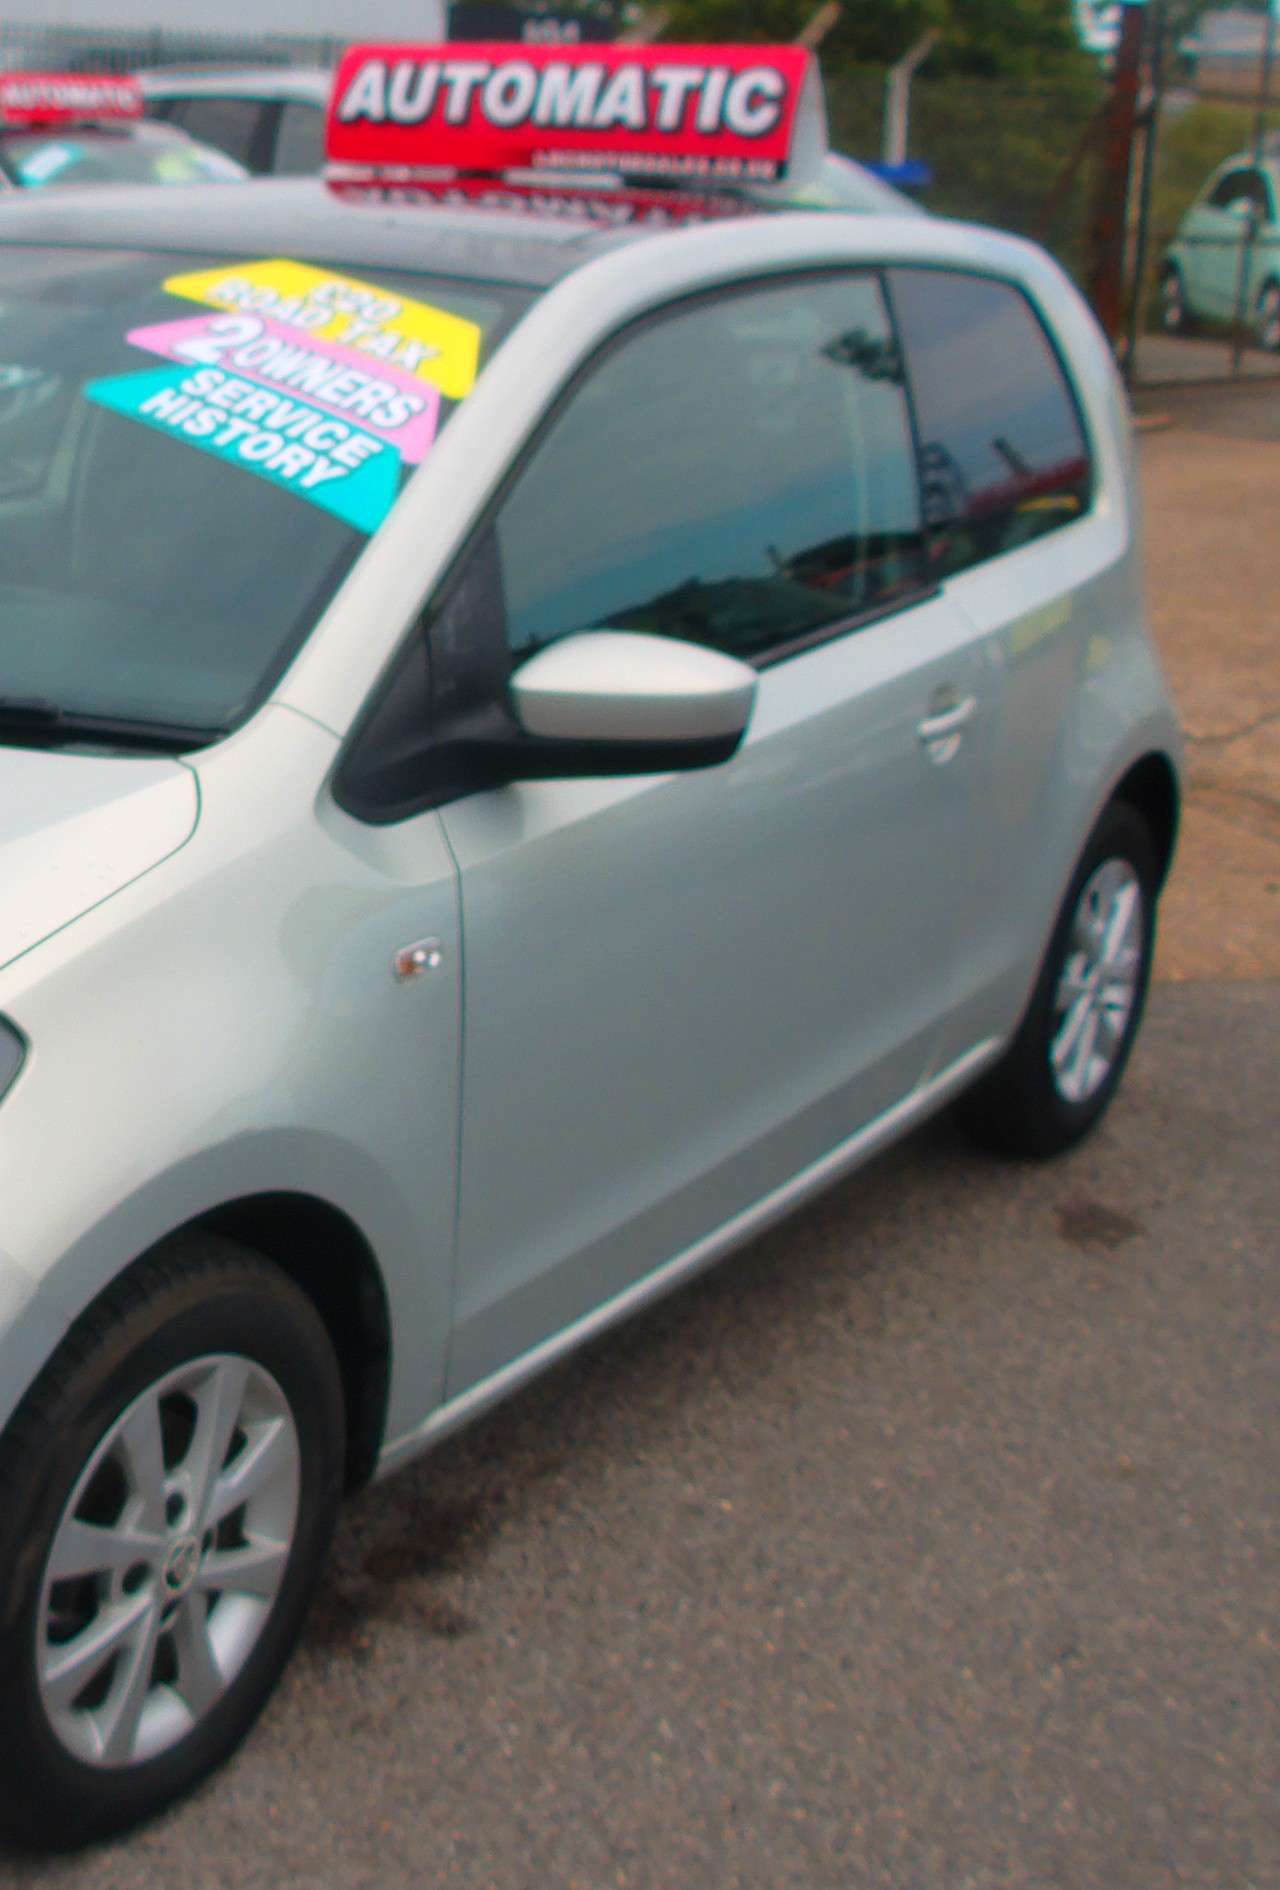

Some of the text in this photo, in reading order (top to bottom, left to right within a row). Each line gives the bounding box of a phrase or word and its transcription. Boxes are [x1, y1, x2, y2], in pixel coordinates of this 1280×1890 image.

[2, 81, 136, 109] AUTOMATIC
[338, 59, 787, 136] AUTOMATIC
[171, 313, 427, 428] 2 OWNERS
[206, 276, 443, 372] ROAD TAX
[139, 387, 350, 487] HISTORY
[181, 367, 384, 468] SERVICE
